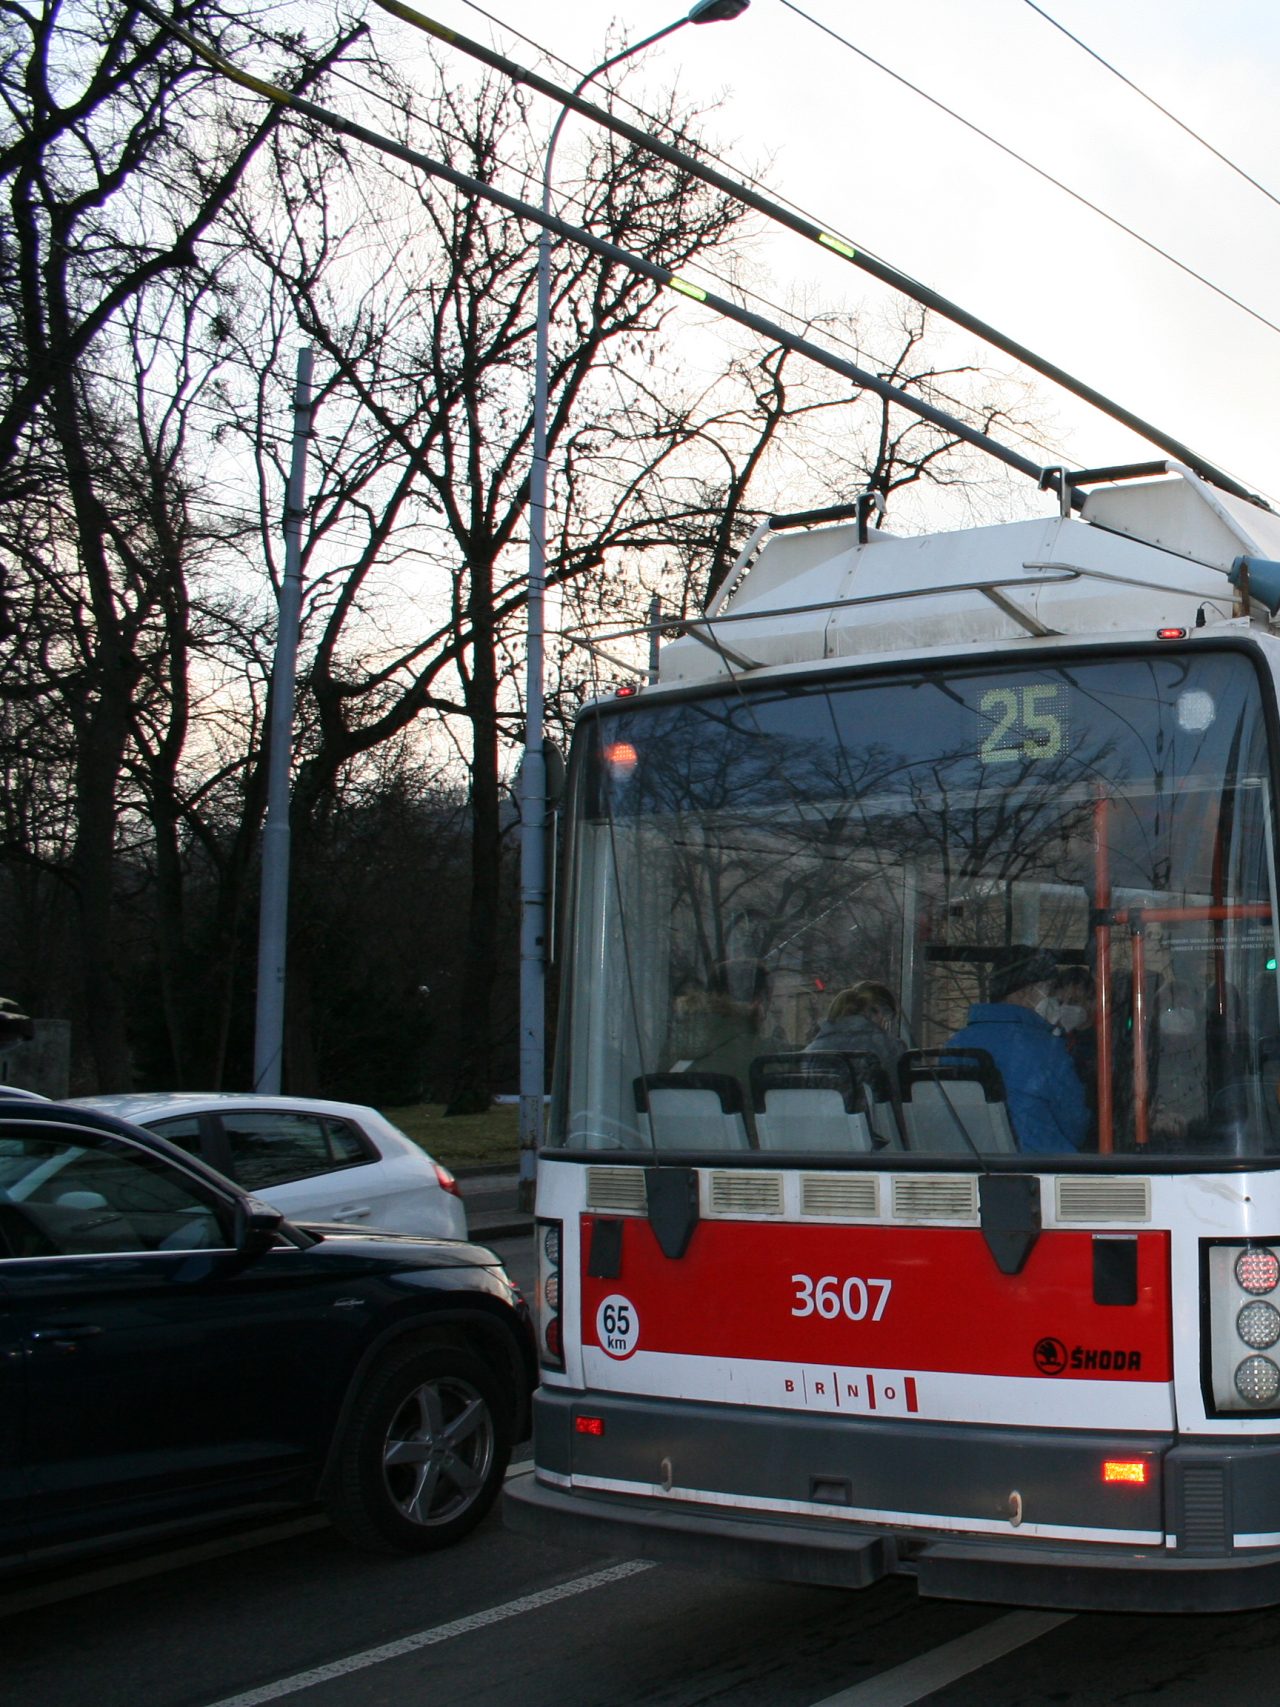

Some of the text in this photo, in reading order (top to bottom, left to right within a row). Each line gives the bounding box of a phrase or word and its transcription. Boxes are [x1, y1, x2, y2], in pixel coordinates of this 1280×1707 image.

[981, 684, 1062, 763] 25
[792, 1273, 891, 1322] 3607
[603, 1303, 630, 1336] 65
[607, 1335, 627, 1351] km
[1070, 1345, 1142, 1371] ŠKODA
